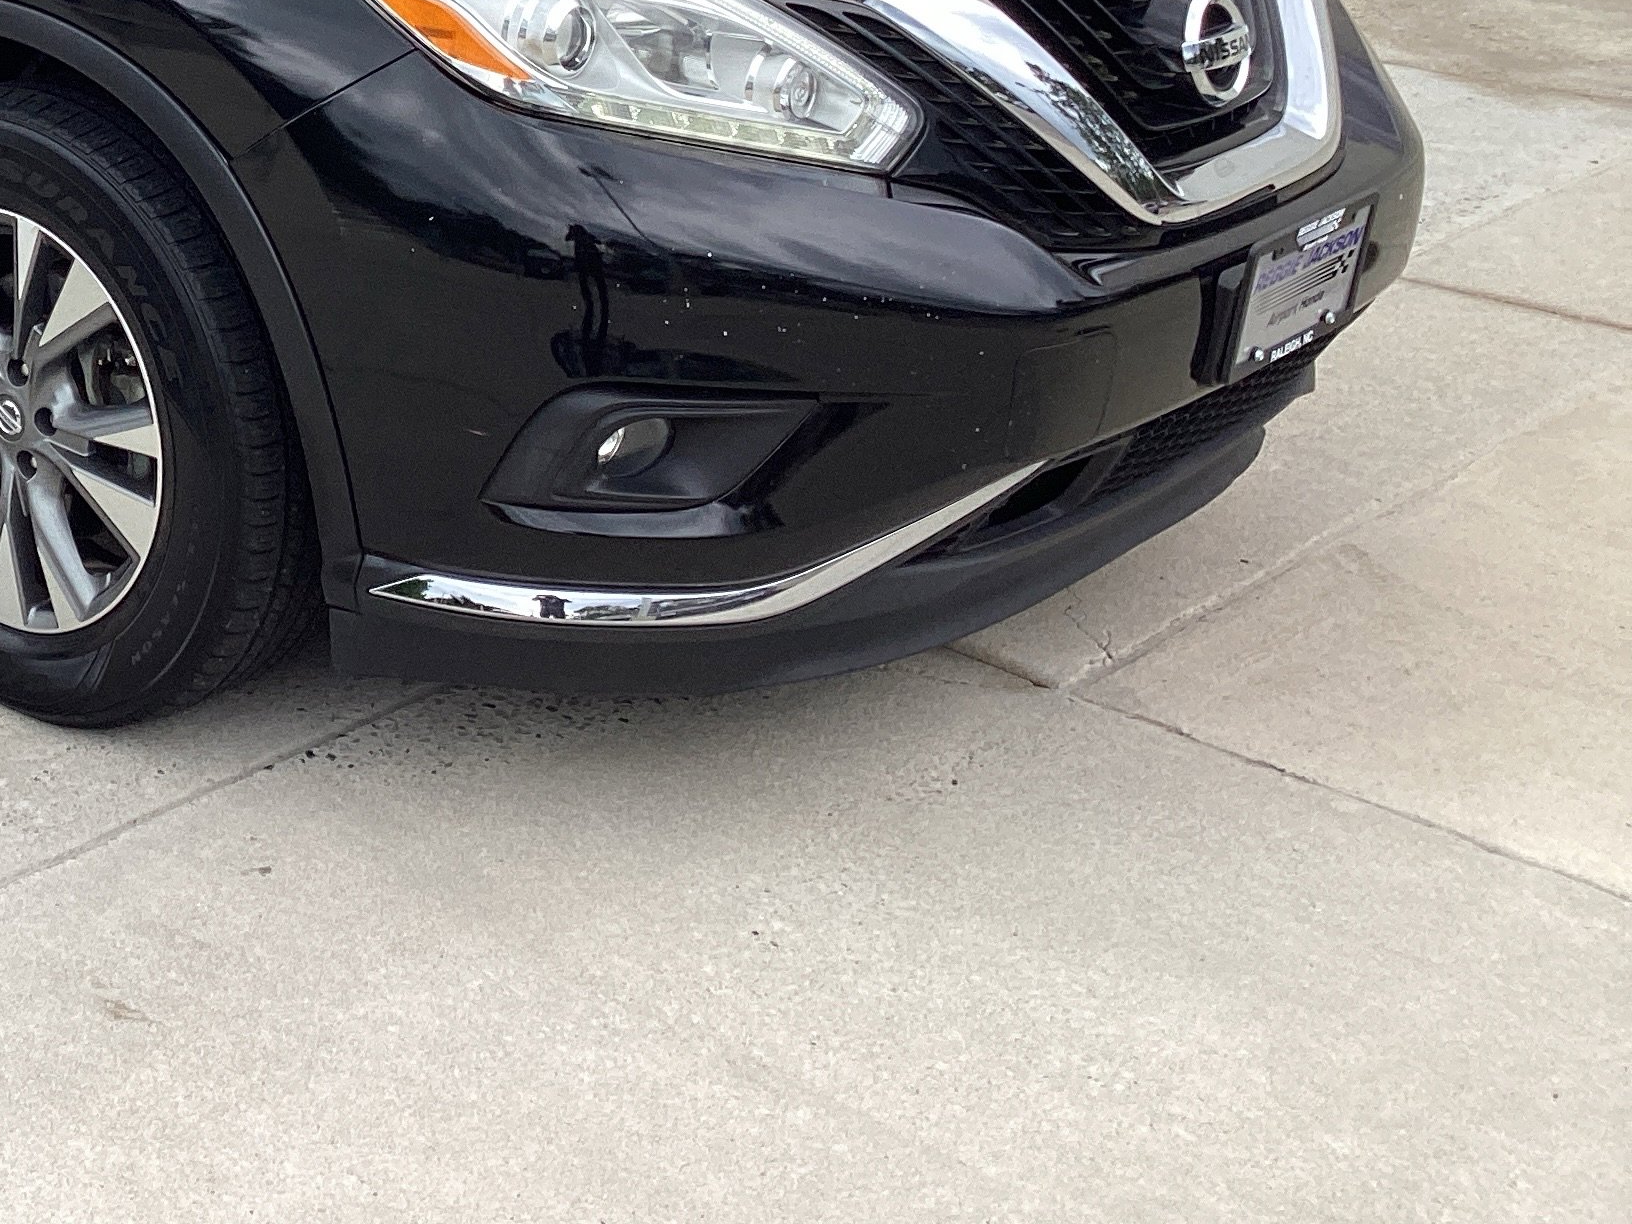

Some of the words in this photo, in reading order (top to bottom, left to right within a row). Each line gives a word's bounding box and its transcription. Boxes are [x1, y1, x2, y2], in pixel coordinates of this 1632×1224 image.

[1199, 33, 1249, 67] NISSA
[1302, 226, 1365, 271] JACKSON
[1302, 329, 1315, 346] NC
